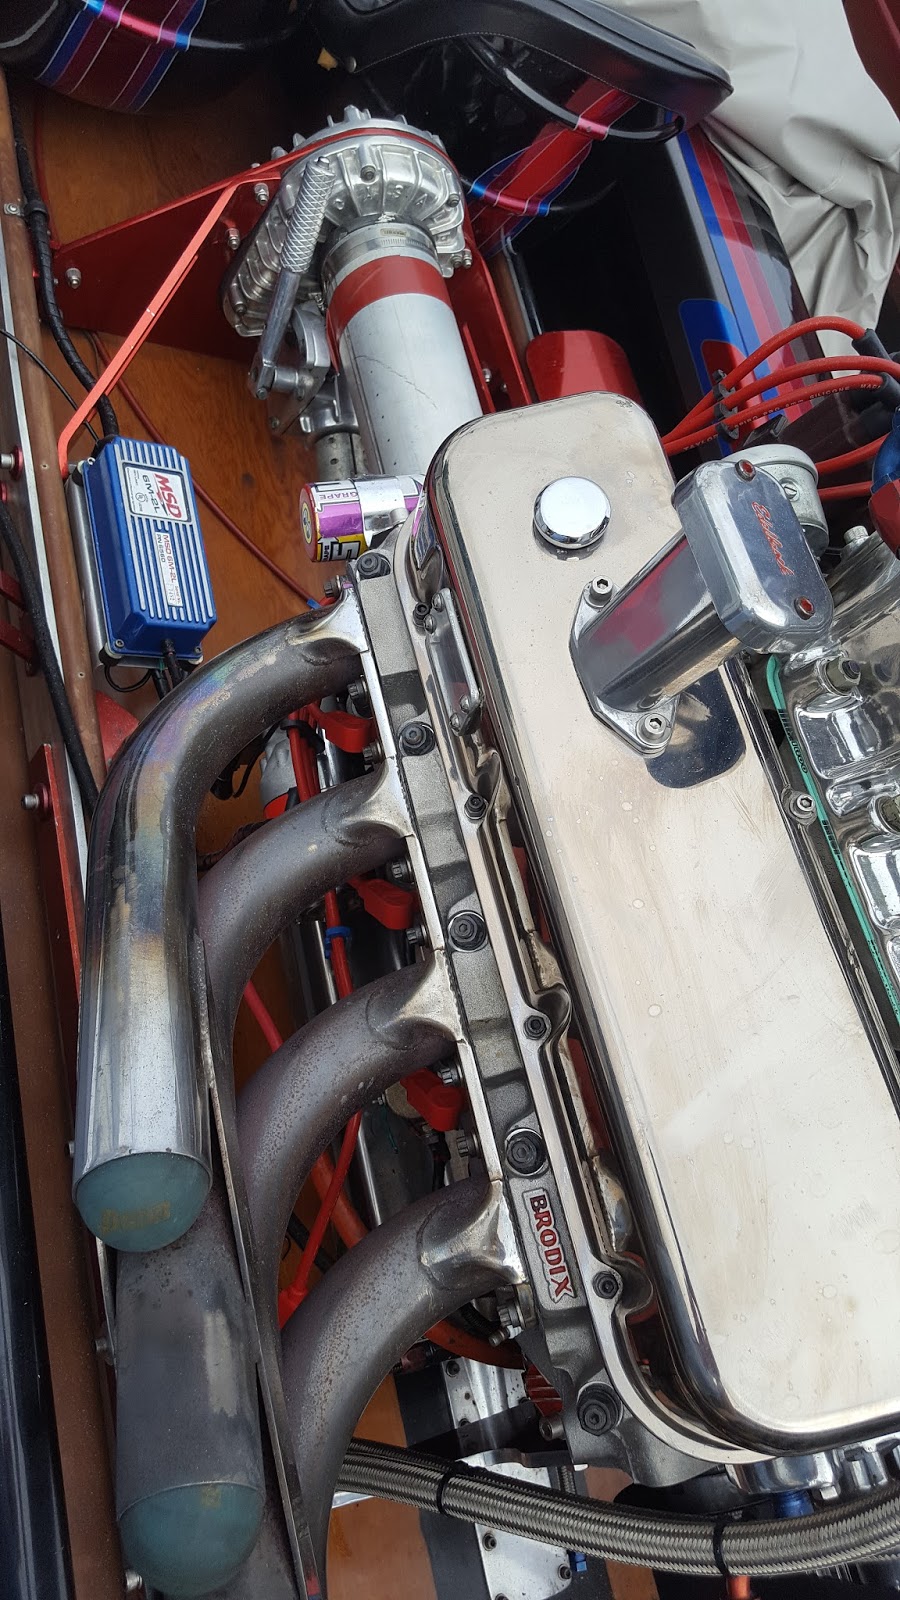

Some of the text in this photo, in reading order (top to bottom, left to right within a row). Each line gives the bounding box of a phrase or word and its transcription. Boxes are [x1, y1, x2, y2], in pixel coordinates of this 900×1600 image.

[809, 386, 850, 400] SILICONE
[142, 474, 162, 513] 6M-2L
[154, 473, 182, 519] MSD
[318, 491, 359, 500] GRAPE
[162, 534, 171, 555] MSD
[751, 501, 795, 576] Edelbrock
[529, 1194, 573, 1298] BRODIX
